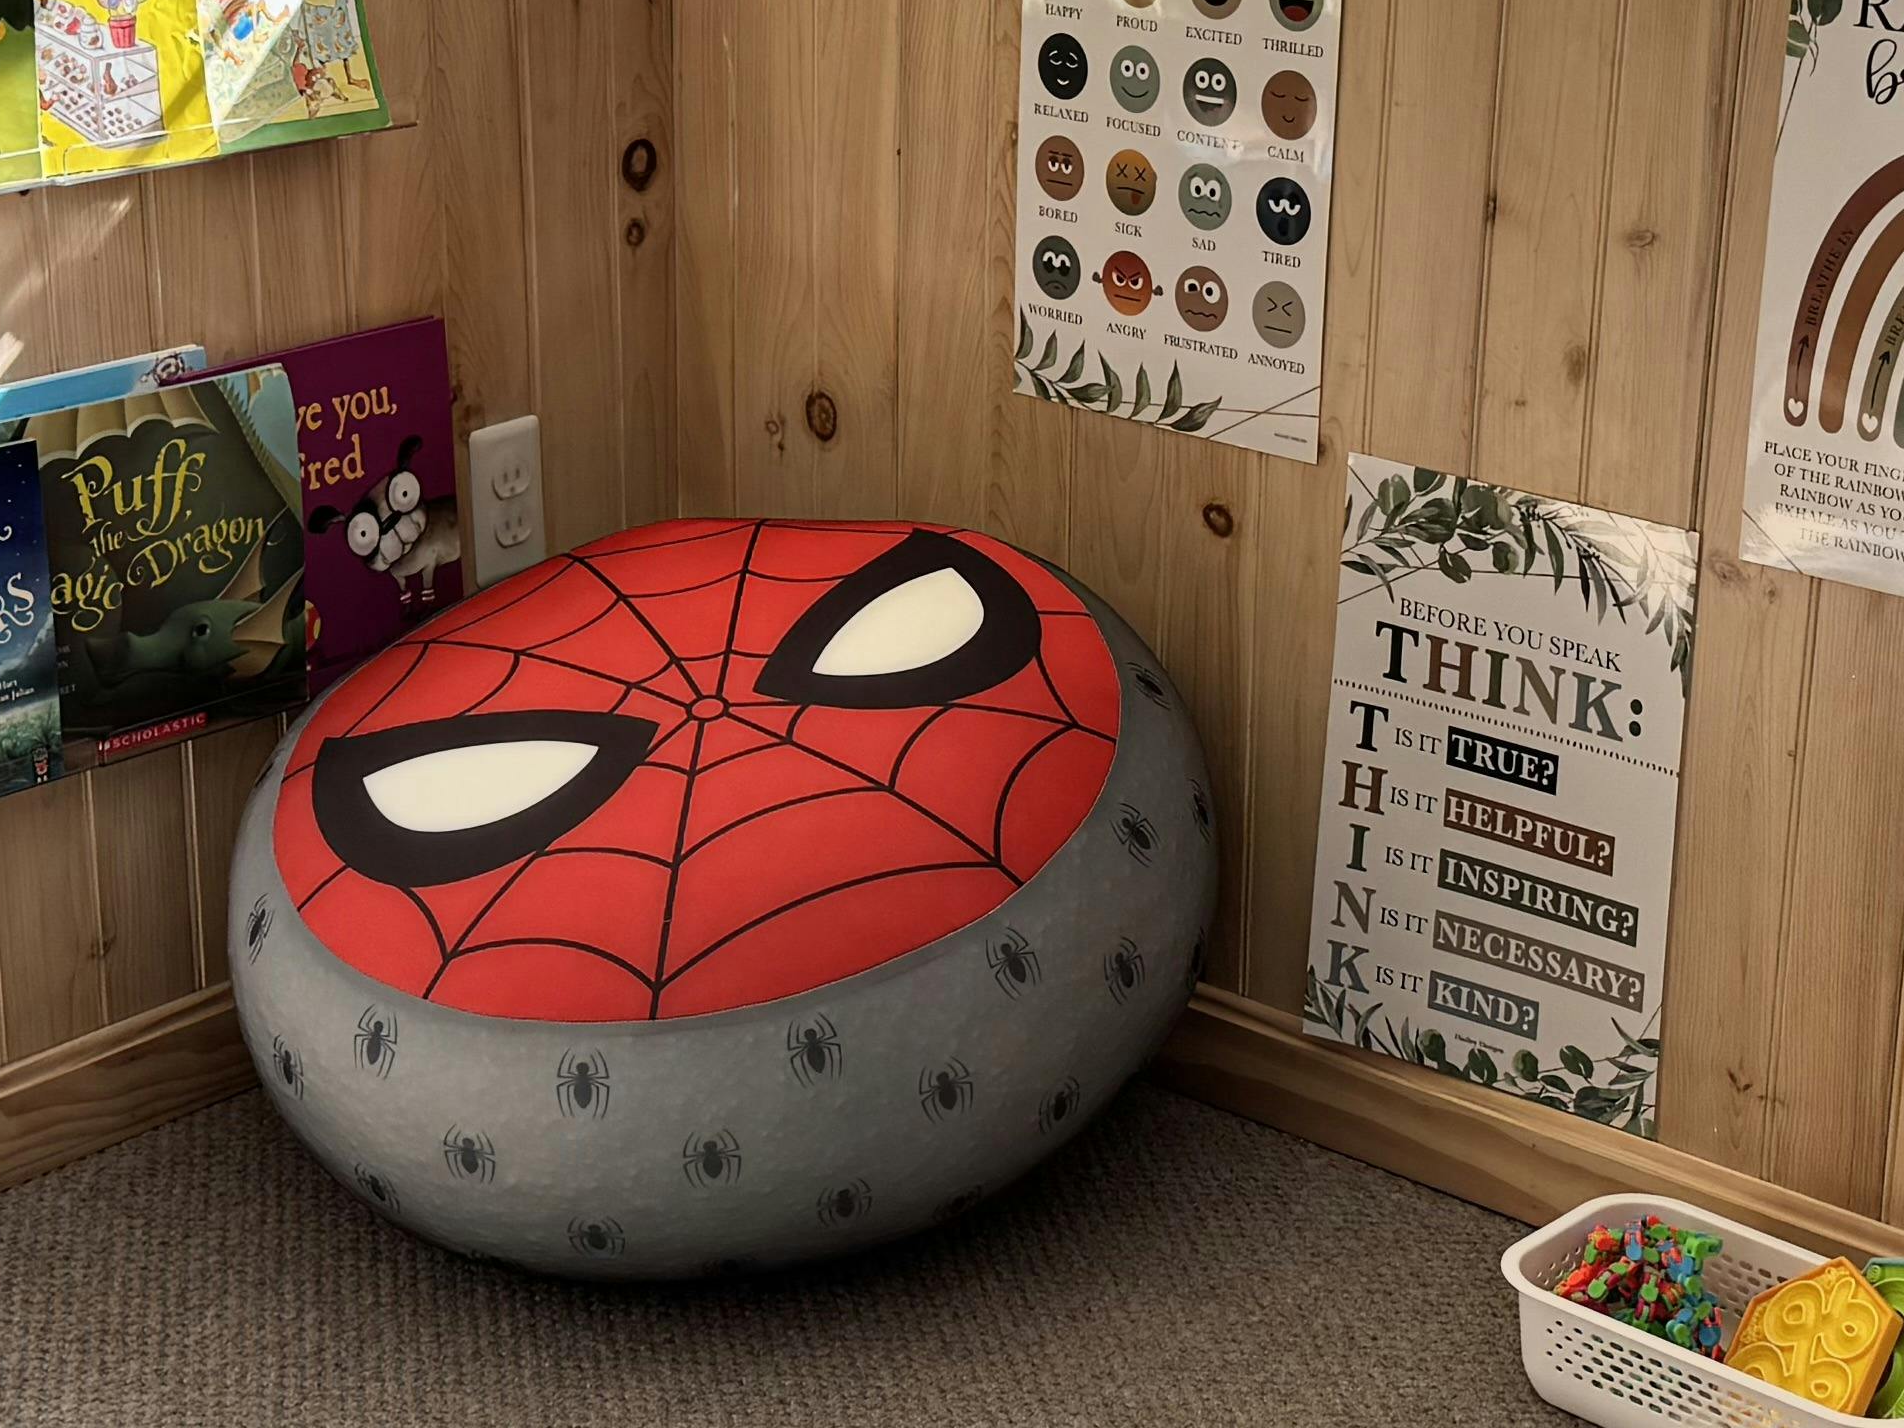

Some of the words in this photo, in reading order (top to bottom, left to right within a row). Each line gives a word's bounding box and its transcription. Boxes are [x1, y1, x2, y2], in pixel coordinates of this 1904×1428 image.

[1045, 3, 1083, 21] HAPPY
[1116, 14, 1158, 33] PROUD
[1185, 26, 1242, 46] EXCITED
[1262, 37, 1324, 58] THRILLED
[1033, 103, 1089, 123] RELAXED
[1106, 116, 1161, 138] FOCUSED
[1038, 205, 1078, 224] BORED
[1114, 221, 1142, 238] SICK
[1191, 237, 1217, 252] SAD
[1261, 251, 1302, 269] TIRED
[1028, 303, 1083, 326] WORRIED
[1106, 322, 1147, 340] ANGRY
[1163, 334, 1238, 360] FRUSTRATED
[1247, 352, 1305, 375] ANNOYED
[331, 385, 398, 440] you,
[1764, 440, 1812, 463] PLACE
[1816, 450, 1860, 473] YOUR
[60, 438, 207, 538] Puff,
[90, 522, 127, 566] the
[126, 515, 266, 589] Dragon
[1399, 597, 1487, 637] BEFORE
[1494, 621, 1543, 650] YOU
[1549, 636, 1622, 673] SPEAK
[1375, 620, 1643, 743] THINK:
[112, 714, 207, 749] SCHOLASTIC
[1349, 700, 1390, 752] T
[1395, 727, 1413, 748] IS
[1419, 733, 1442, 755] IT
[1451, 733, 1555, 785] TRUE?
[1338, 759, 1389, 816] H
[1390, 786, 1410, 806] IS
[1415, 793, 1438, 814] IT
[1446, 796, 1611, 867] HELPFUL?
[1346, 823, 1371, 872] I
[1385, 846, 1404, 867] IS
[1410, 852, 1433, 874] IT
[1444, 857, 1634, 937] INSPIRING?
[1330, 879, 1377, 935] N
[1379, 906, 1399, 927] IS
[1405, 913, 1428, 935] IT
[1436, 918, 1642, 1003] NECESSARY?
